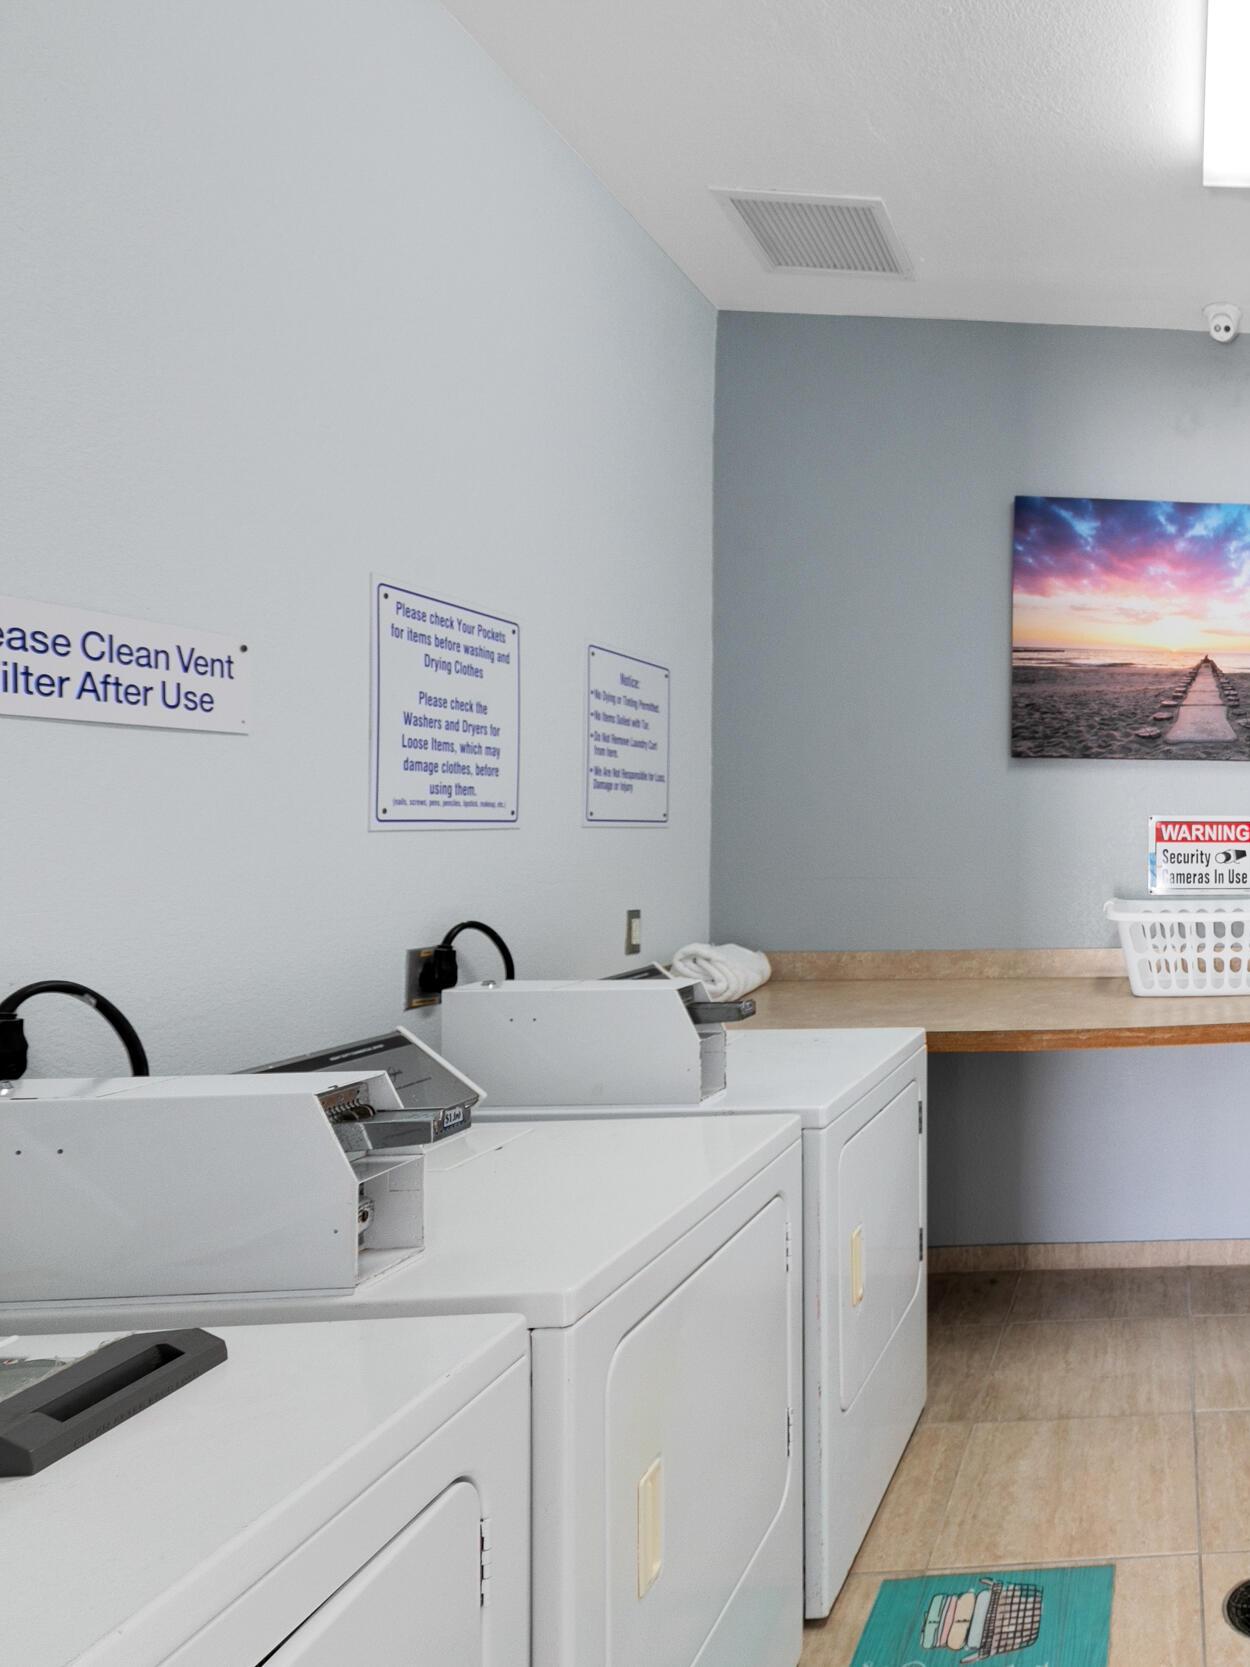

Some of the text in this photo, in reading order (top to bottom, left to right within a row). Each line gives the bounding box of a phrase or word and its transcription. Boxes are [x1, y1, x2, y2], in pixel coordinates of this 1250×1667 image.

[396, 601, 506, 643] Please check Your Pockets
[0, 626, 234, 680] ase Clean Vent
[391, 624, 510, 664] for items before washing and
[424, 653, 484, 679] Drying Clothes
[76, 671, 153, 706] After
[161, 680, 214, 712] Use
[419, 691, 488, 715] Please check the
[403, 712, 500, 737] Washers and Dryers for
[402, 734, 500, 760] Loose Items, which may
[403, 757, 500, 777] damage clothes, before
[430, 782, 476, 798] using them.
[1160, 824, 1250, 842] WARNING
[1162, 848, 1211, 868] Security
[1214, 869, 1224, 884] In
[1228, 869, 1248, 884] Use
